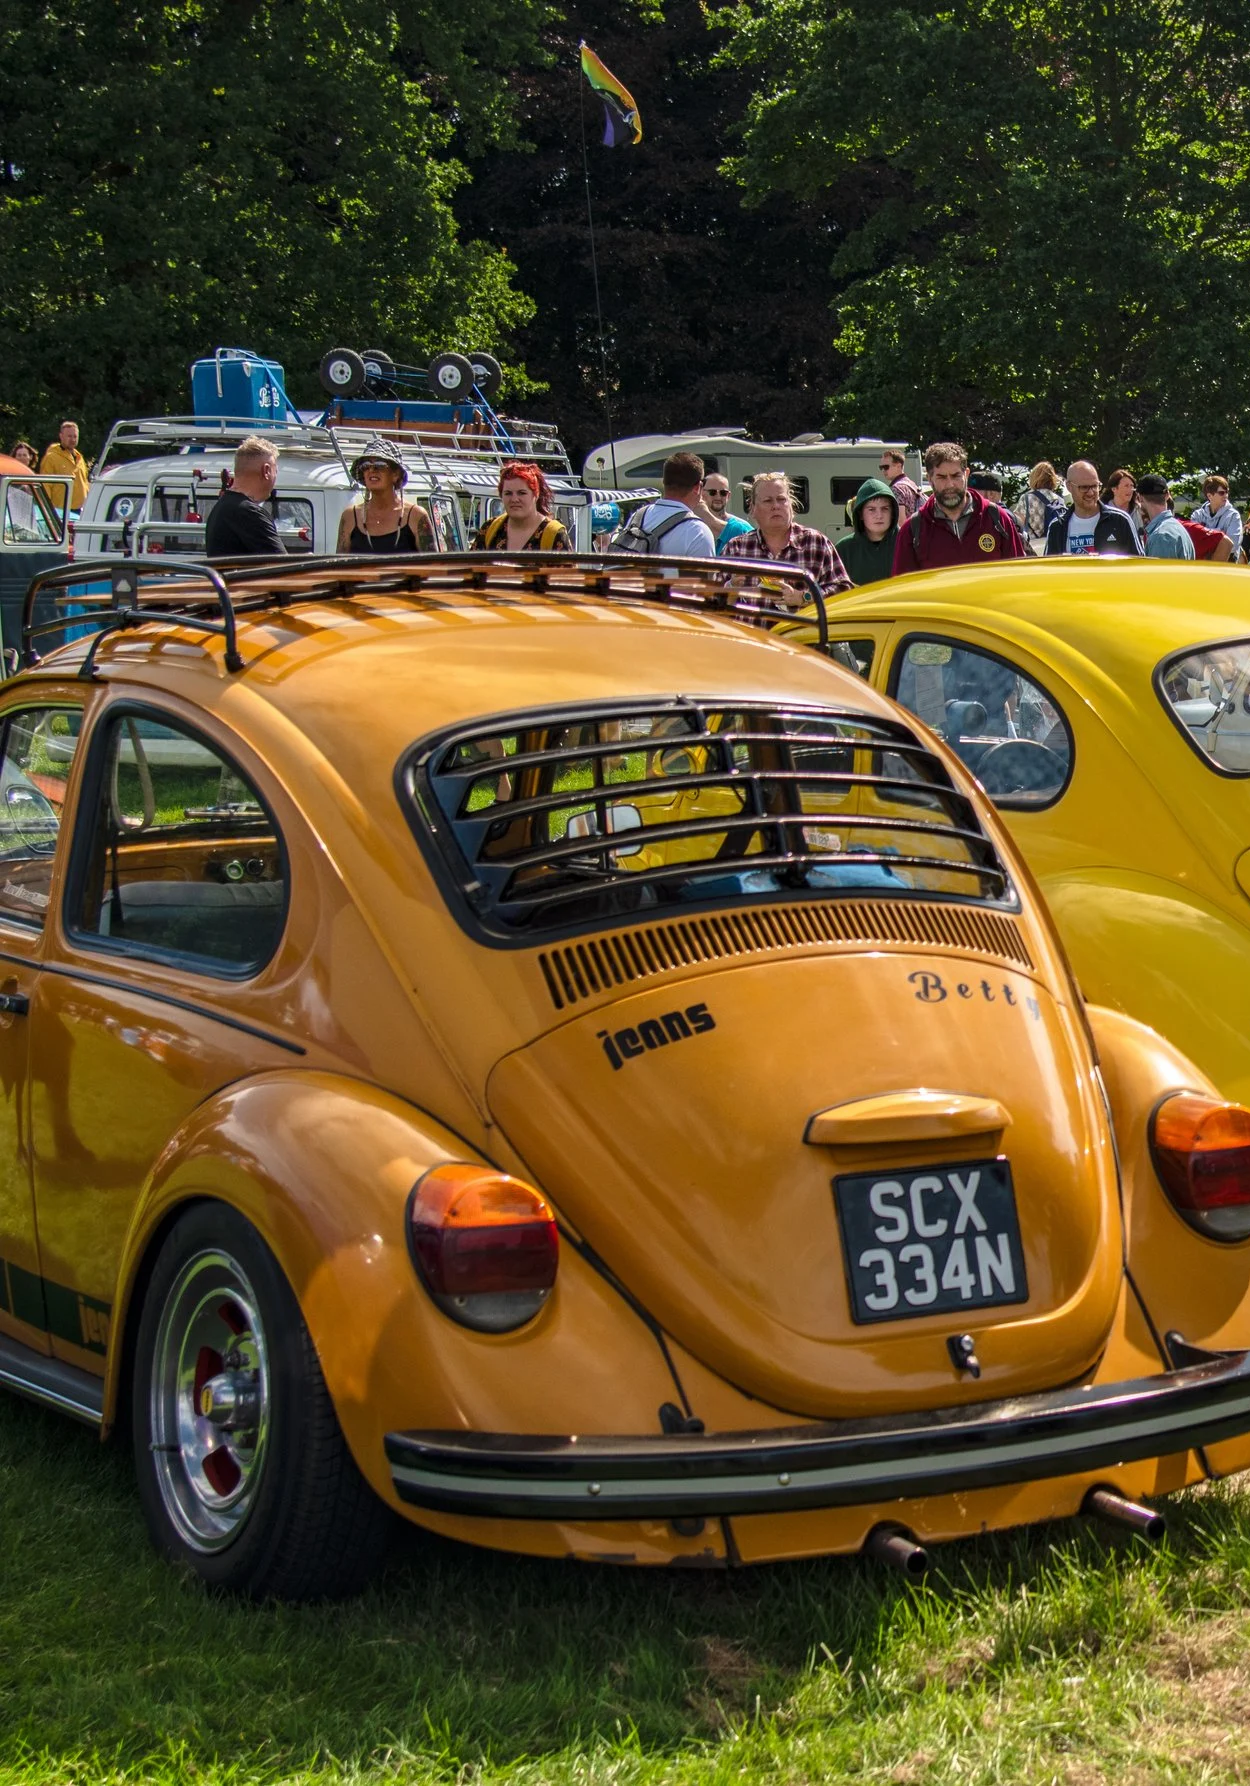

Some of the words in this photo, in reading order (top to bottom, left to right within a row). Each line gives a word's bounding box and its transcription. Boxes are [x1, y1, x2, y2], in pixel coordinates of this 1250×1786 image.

[1071, 538, 1085, 547] NEW
[907, 970, 1040, 1021] Betty
[596, 1002, 717, 1072] jenns
[869, 1171, 988, 1243] SCX
[859, 1233, 1016, 1311] 334N
